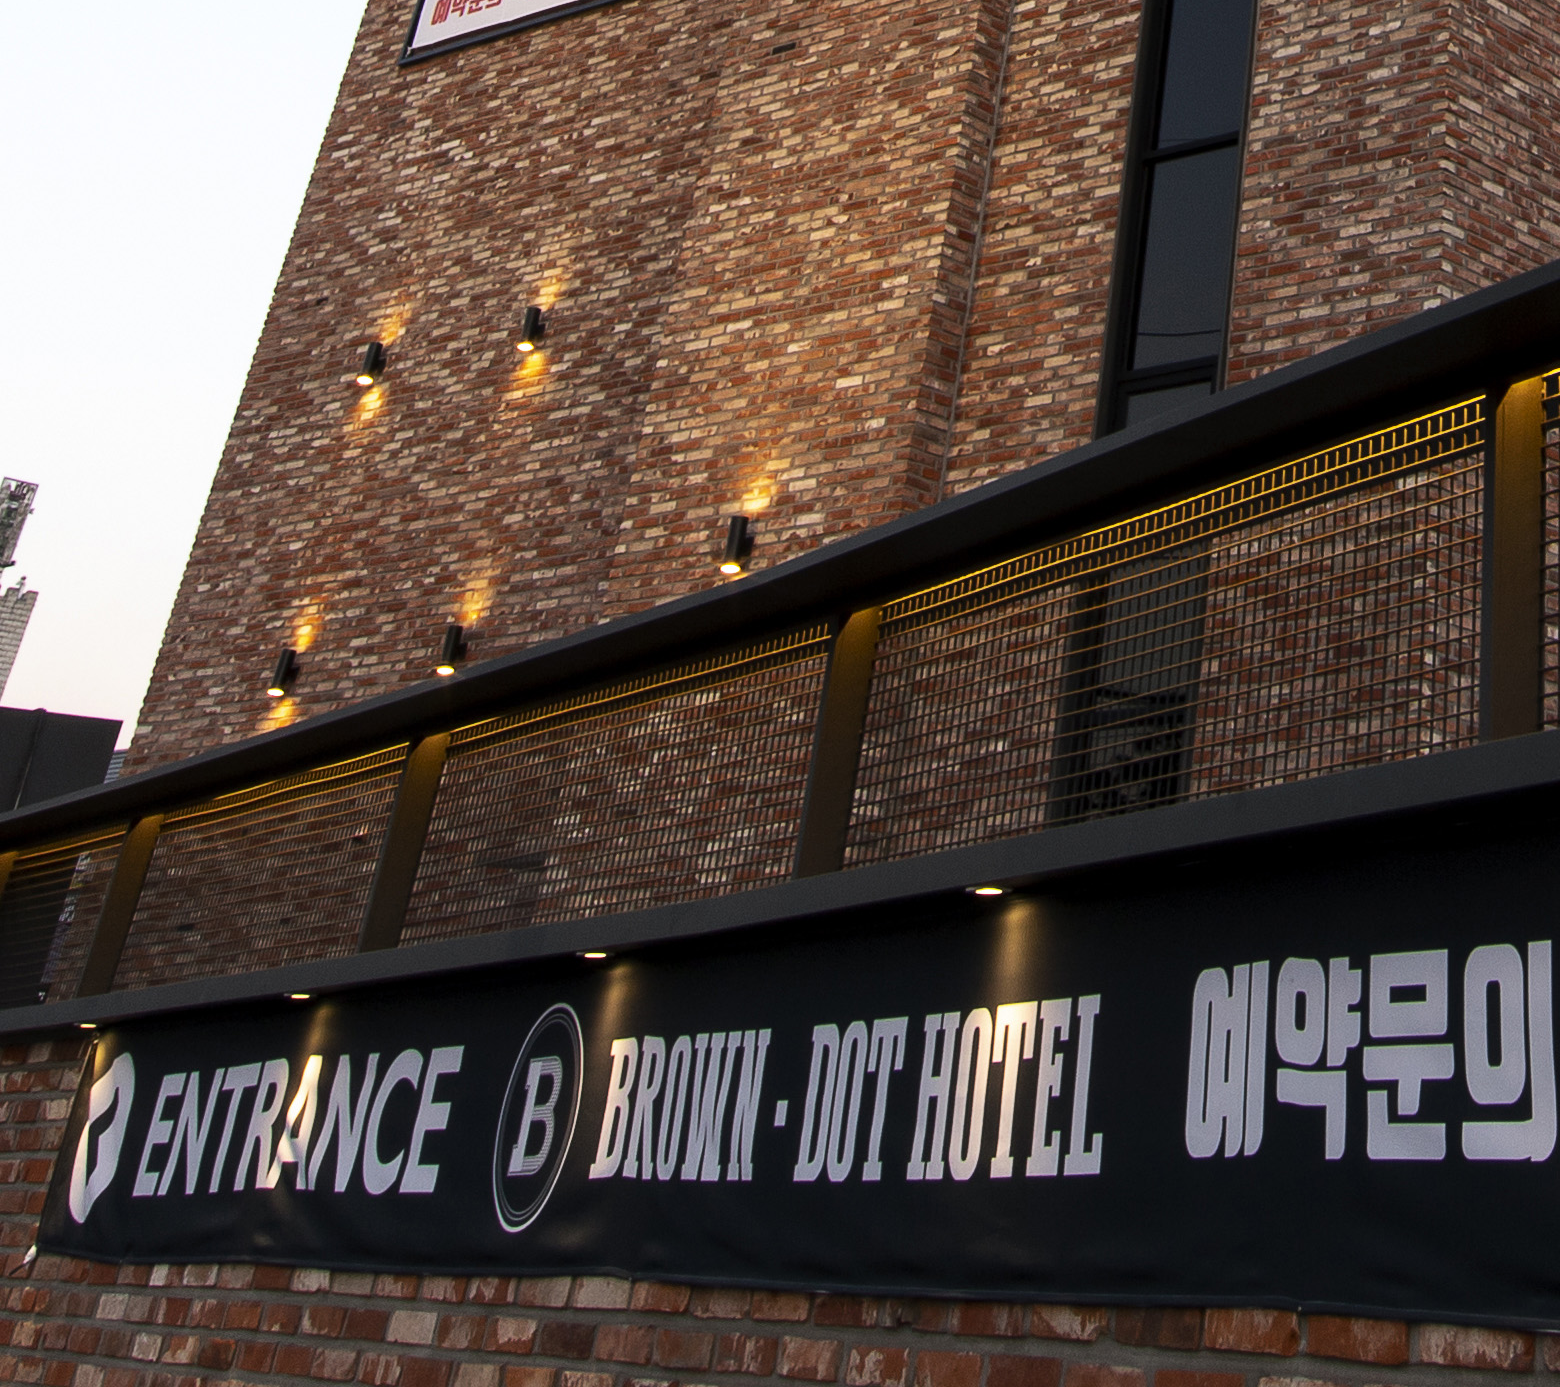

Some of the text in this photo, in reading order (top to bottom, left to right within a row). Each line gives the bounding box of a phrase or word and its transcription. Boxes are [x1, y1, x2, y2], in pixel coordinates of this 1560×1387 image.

[131, 1044, 466, 1198] ENTRANCE
[507, 1055, 563, 1177] B
[588, 1027, 772, 1184] BROWN
[794, 1017, 910, 1184] DOT
[907, 993, 1103, 1182] HOTEL
[1181, 938, 1556, 1165] 예약문의
